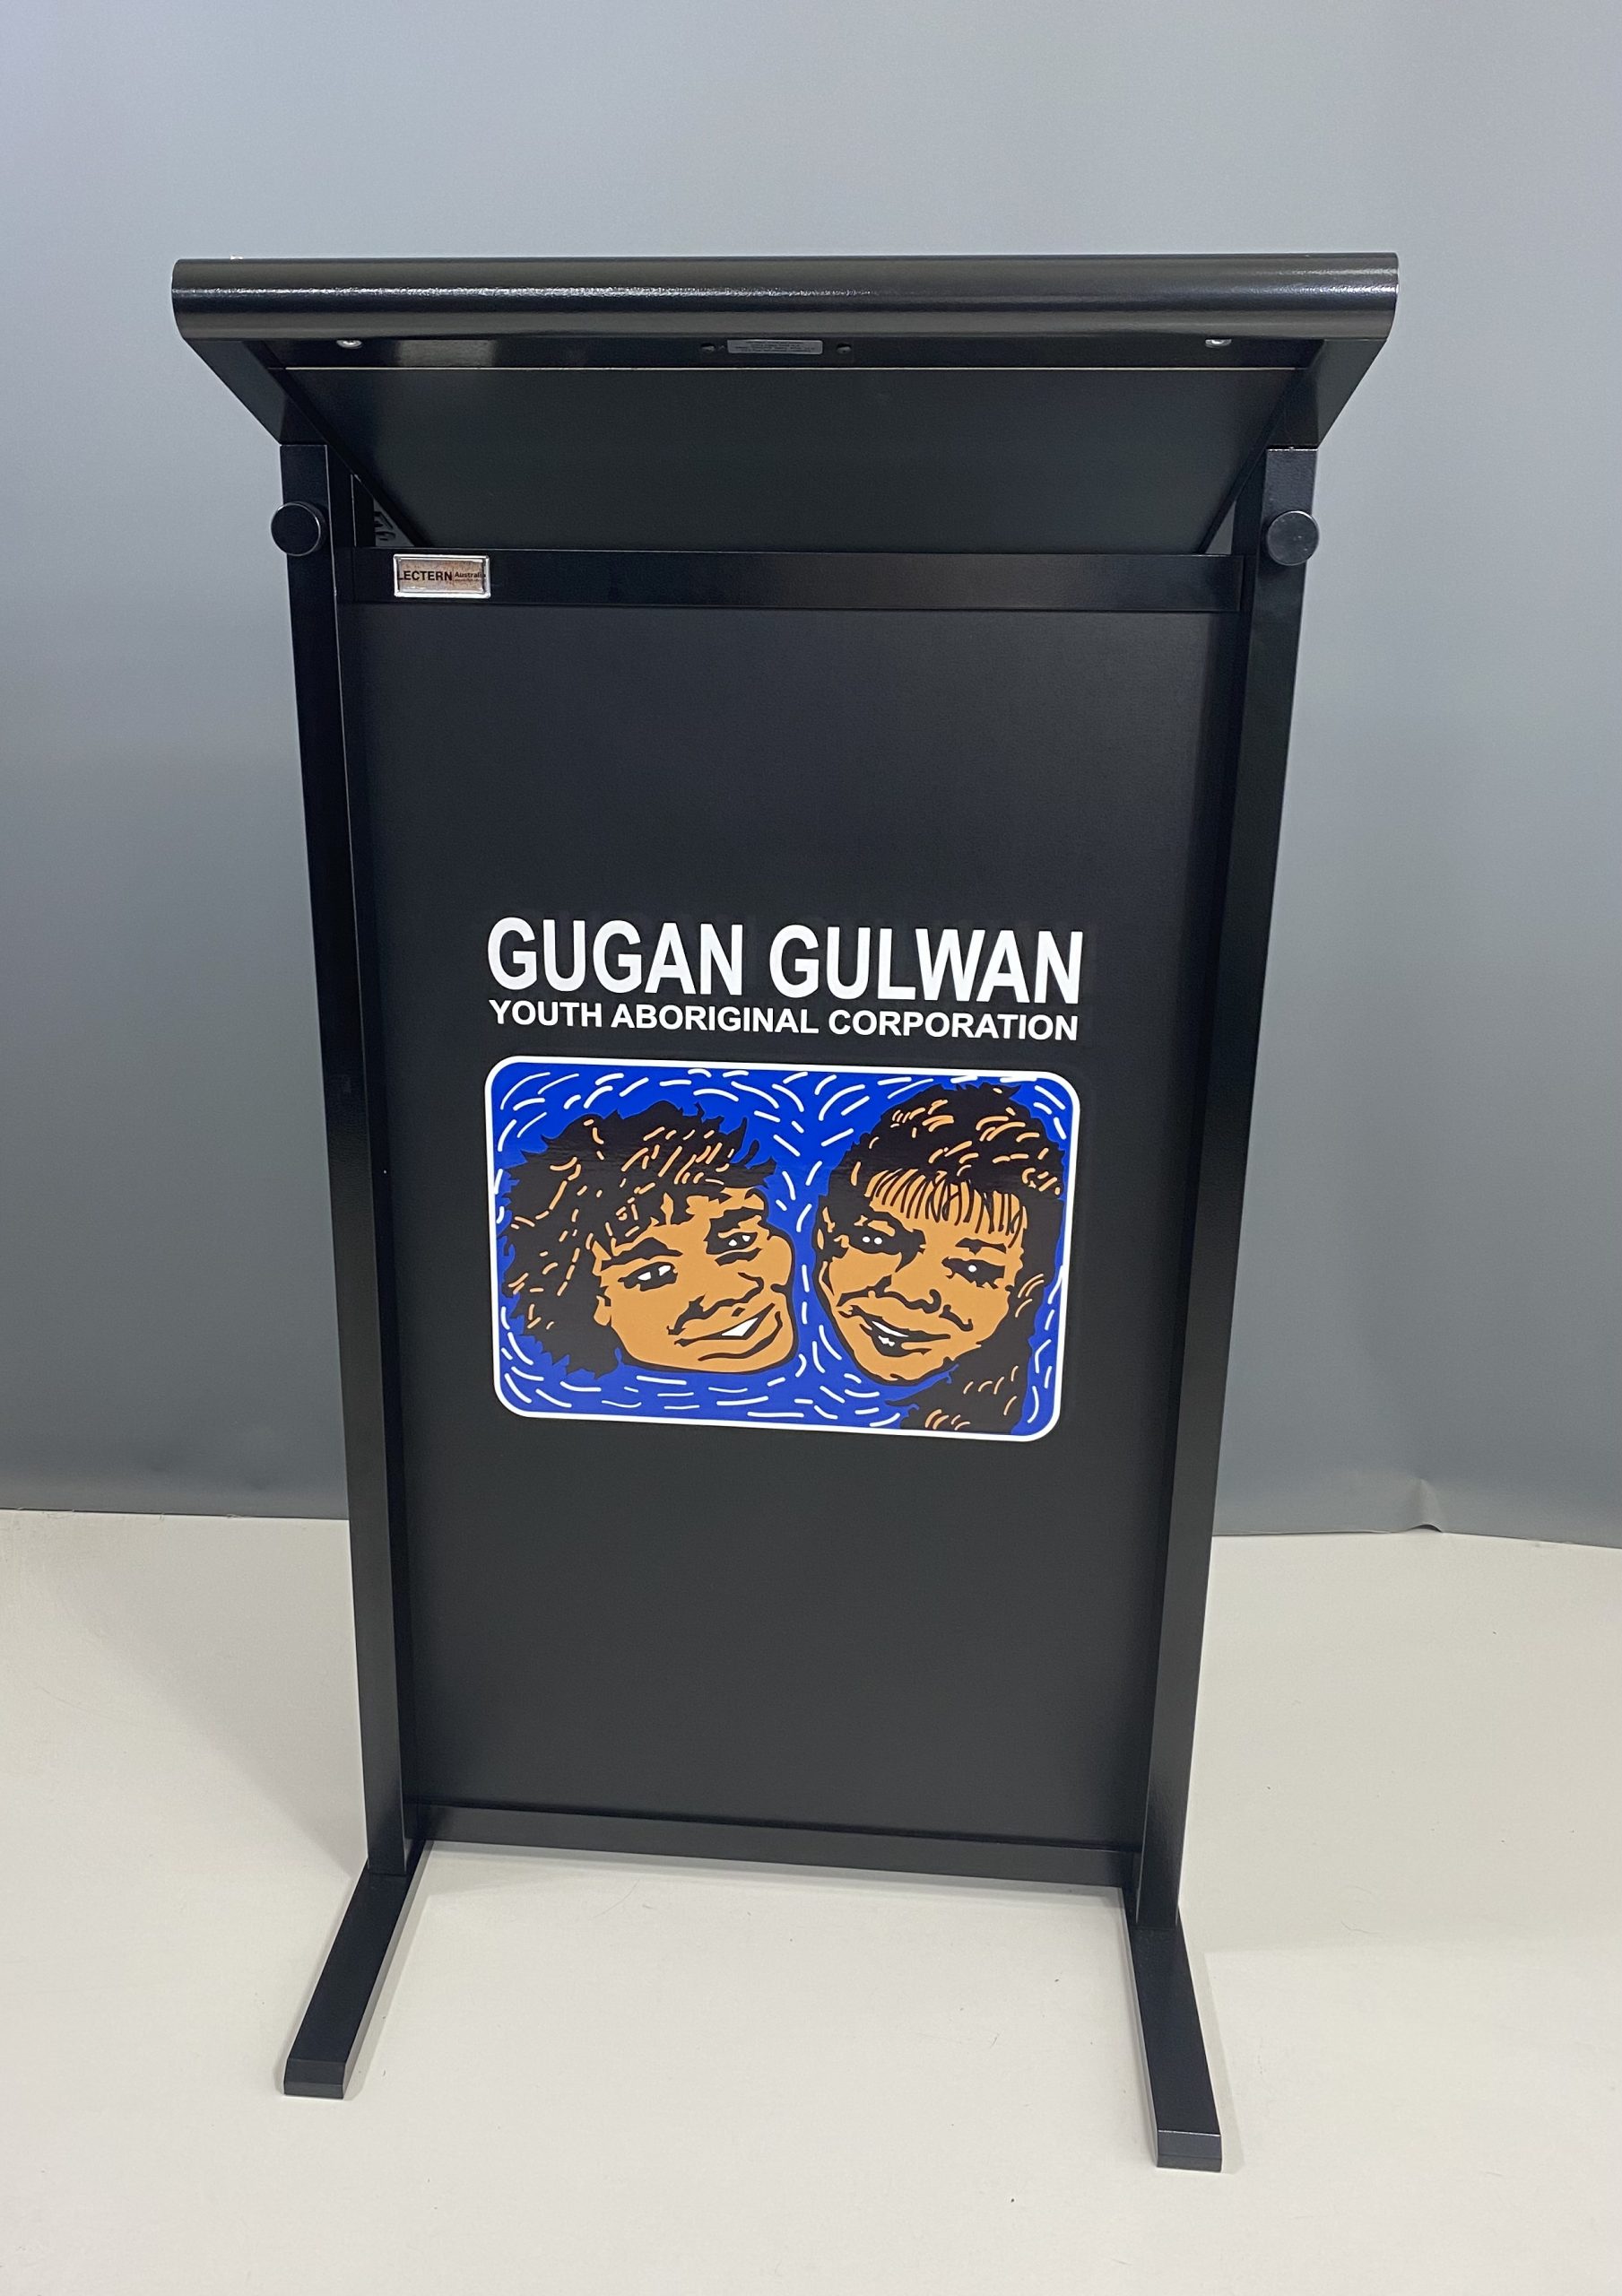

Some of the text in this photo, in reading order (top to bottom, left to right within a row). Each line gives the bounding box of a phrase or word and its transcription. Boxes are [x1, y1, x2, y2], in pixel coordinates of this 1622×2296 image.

[397, 570, 453, 581] LECTERN
[487, 918, 1083, 1004] GUGAN GULWAN
[488, 1000, 1079, 1040] YOUTH ABORIGINAL CORPORATION
